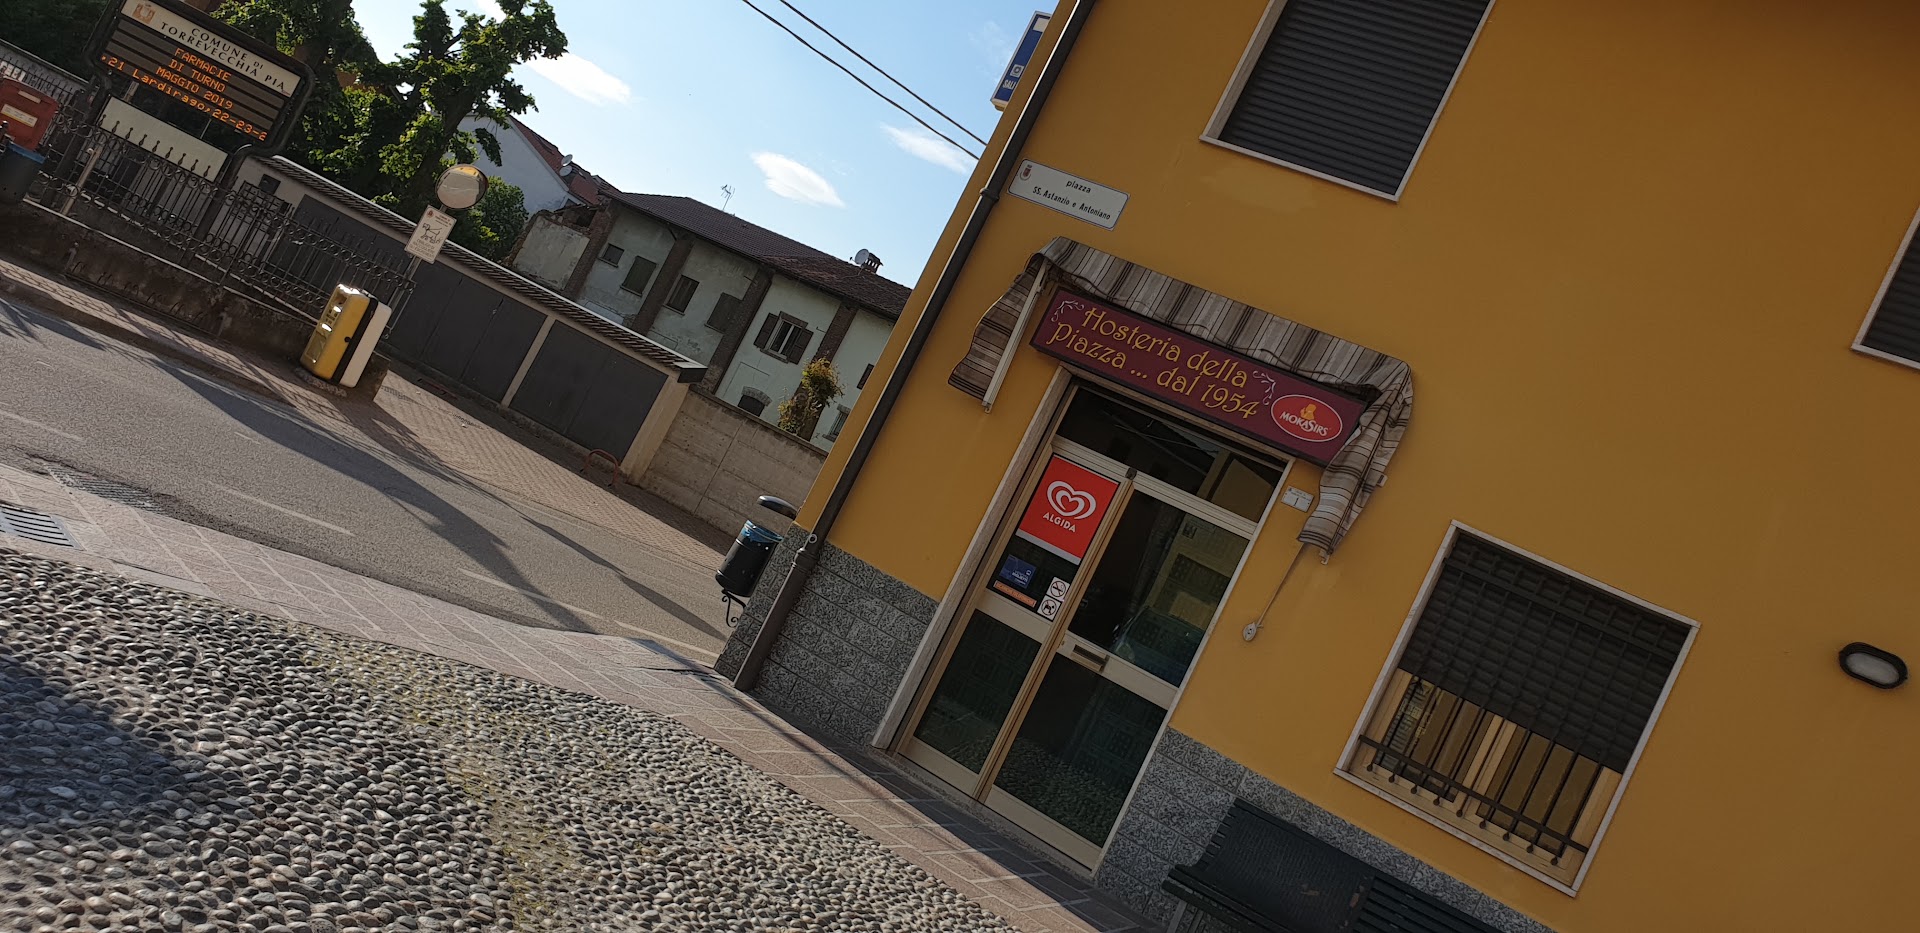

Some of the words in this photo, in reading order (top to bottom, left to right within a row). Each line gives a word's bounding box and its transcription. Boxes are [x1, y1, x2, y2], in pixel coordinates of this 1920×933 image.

[160, 21, 258, 77] TORREVECCHIA
[264, 74, 285, 92] PIA
[174, 47, 232, 82] FARMACIE
[191, 28, 248, 61] COMUNE
[253, 61, 263, 70] DI
[155, 66, 200, 93] MAGGIO
[203, 90, 233, 110] 2019
[168, 59, 185, 72] DI
[192, 68, 226, 93] TURNO
[1032, 186, 1042, 196] SS.
[1042, 190, 1070, 206] Astanzio
[1079, 202, 1111, 220] Antoniano
[1065, 180, 1092, 194] piazza
[1081, 307, 1181, 363] Hosteria
[1186, 350, 1248, 388] della
[1046, 322, 1127, 369] Piazza
[1156, 367, 1201, 396] dal
[1200, 383, 1260, 419] 1954
[1043, 511, 1076, 533] ALGIDA
